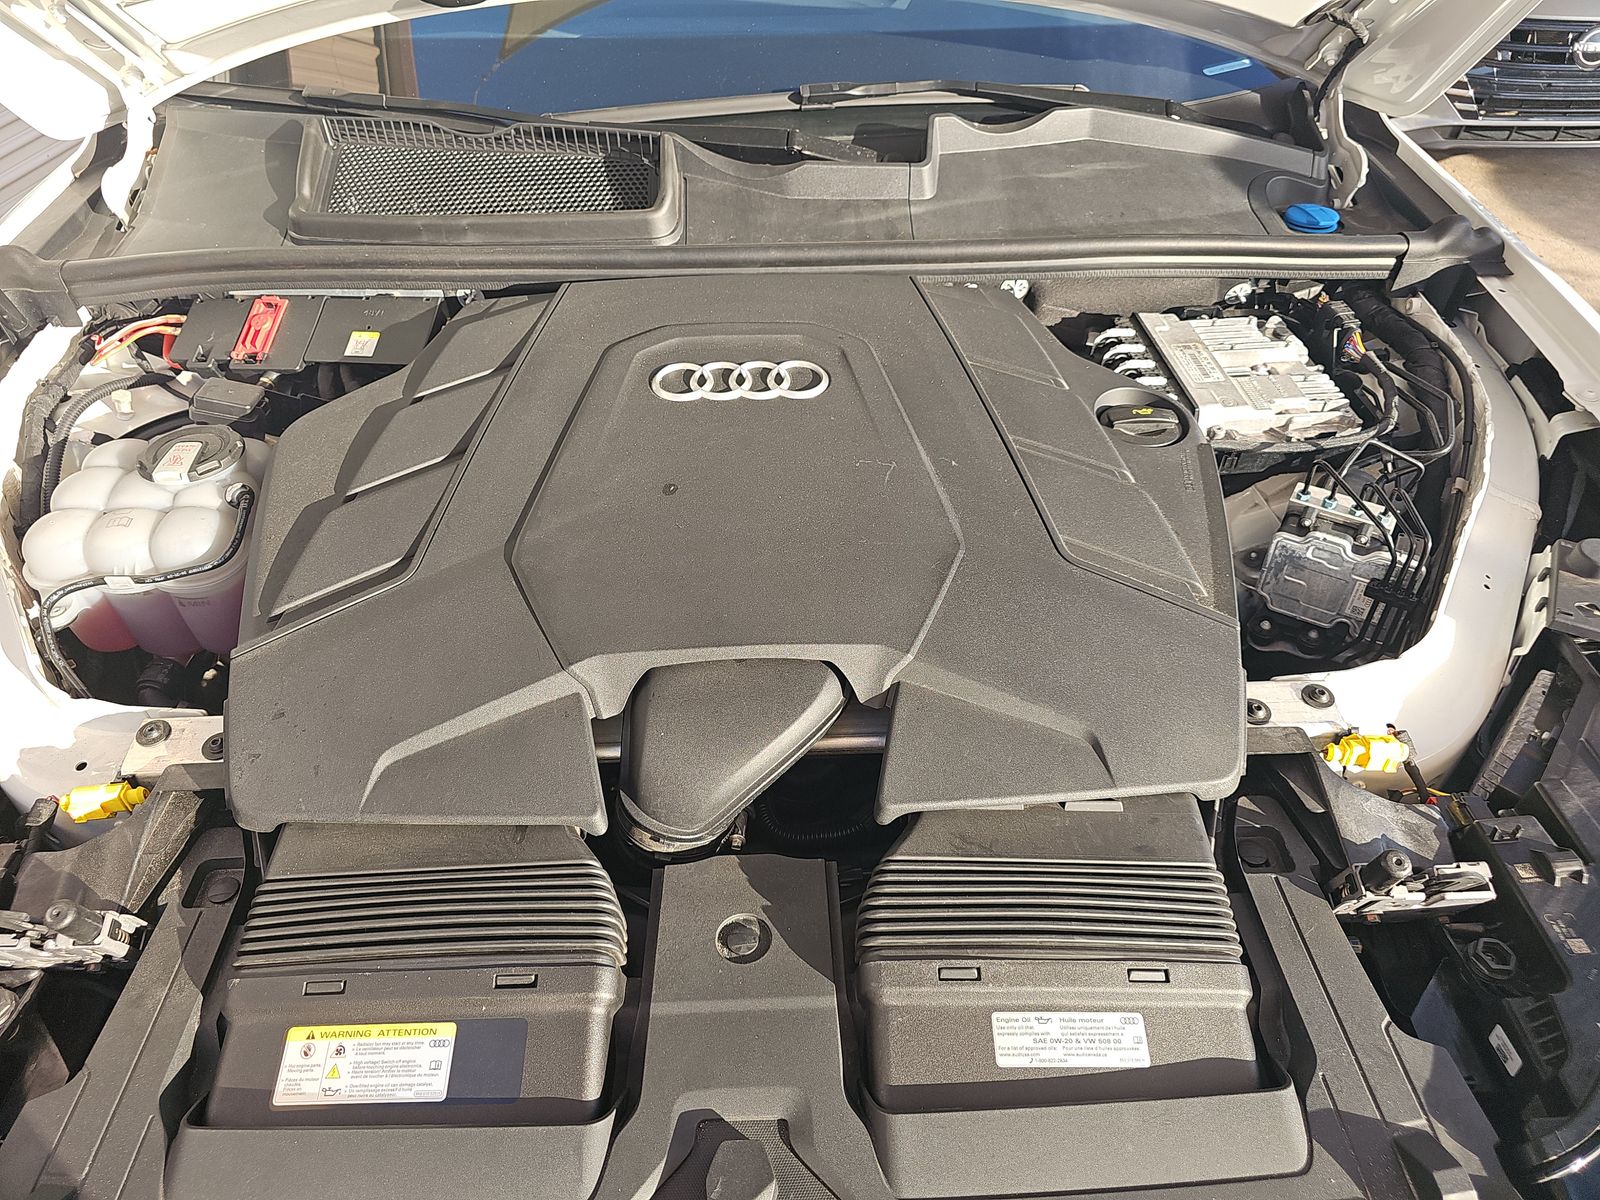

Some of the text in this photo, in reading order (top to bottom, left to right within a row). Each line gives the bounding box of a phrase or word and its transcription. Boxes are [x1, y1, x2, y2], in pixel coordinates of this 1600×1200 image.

[996, 1016, 1020, 1024] Engine
[320, 1027, 438, 1039] WARNING ATTENTION
